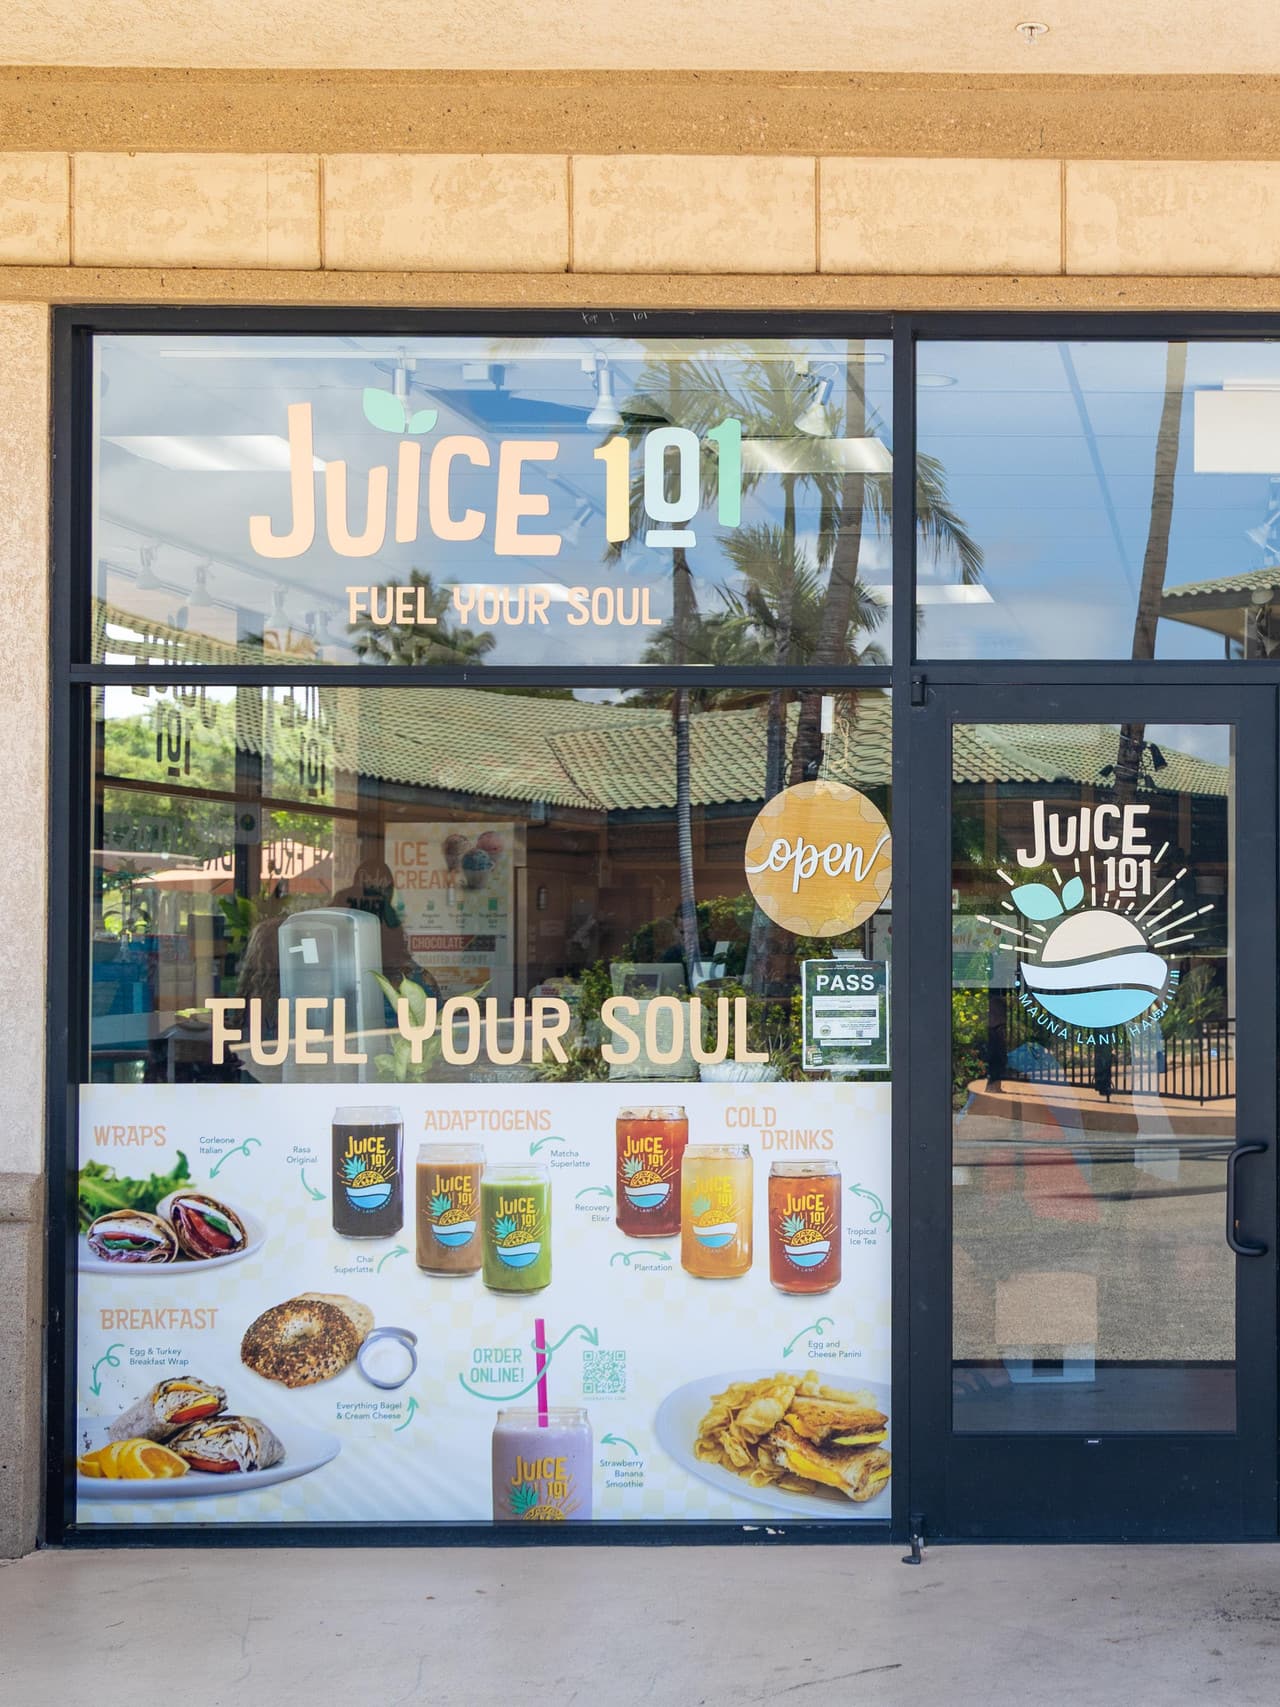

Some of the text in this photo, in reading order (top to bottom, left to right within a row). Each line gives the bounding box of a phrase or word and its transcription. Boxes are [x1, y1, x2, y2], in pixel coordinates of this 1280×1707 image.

[249, 402, 742, 559] JUICE 101
[346, 586, 662, 626] FUEL YOUR SOUL
[1016, 800, 1152, 868] JUICE
[393, 841, 429, 866] ICE
[745, 832, 893, 893] open
[393, 870, 458, 890] CREAM
[1103, 857, 1151, 897] 101
[816, 974, 875, 991] PASS
[1019, 993, 1068, 1040] MAUNA
[1077, 1034, 1124, 1045] LANI,
[204, 996, 770, 1065] FUEL YOUR SOUL
[424, 1109, 552, 1132] ADAPTOGENS
[725, 1106, 777, 1128] COLD
[93, 1125, 167, 1147] WRAPS
[199, 1136, 236, 1144] Corleone
[761, 1129, 834, 1151] DRINKS
[344, 1135, 386, 1158] JUICE
[623, 1135, 664, 1157] JUICE
[286, 1156, 318, 1165] Original
[371, 1154, 386, 1167] 101
[550, 1159, 591, 1168] Superlatte
[648, 1154, 664, 1167] 101
[431, 1174, 472, 1196] JUICE
[458, 1193, 472, 1205] 101
[495, 1196, 536, 1218] JUICE
[783, 1193, 825, 1216] JUICE
[575, 1204, 611, 1212] Recovery
[521, 1214, 536, 1227] 101
[591, 1214, 611, 1222] Elixir
[810, 1211, 825, 1225] 101
[847, 1228, 877, 1237] Tropical
[356, 1255, 374, 1263] Chai
[634, 1263, 673, 1271] Plantation
[334, 1265, 374, 1274] Superlatte
[100, 1308, 219, 1330] BREAKFAST
[130, 1347, 146, 1357] Egg
[156, 1347, 182, 1357] Turkey
[807, 1340, 840, 1350] Egg and
[473, 1348, 522, 1364] ORDER
[807, 1350, 862, 1358] Cheese Panini
[130, 1357, 189, 1368] Breakfast Wrap
[470, 1366, 525, 1383] ONLINE!
[336, 1402, 402, 1411] Everything Bagel
[336, 1412, 401, 1420] & Cream Cheese
[511, 1456, 568, 1486] JUICE
[600, 1459, 644, 1469] Strawberry
[614, 1470, 644, 1478] Banana
[548, 1482, 567, 1499] 101
[605, 1480, 644, 1488] Smoothie
